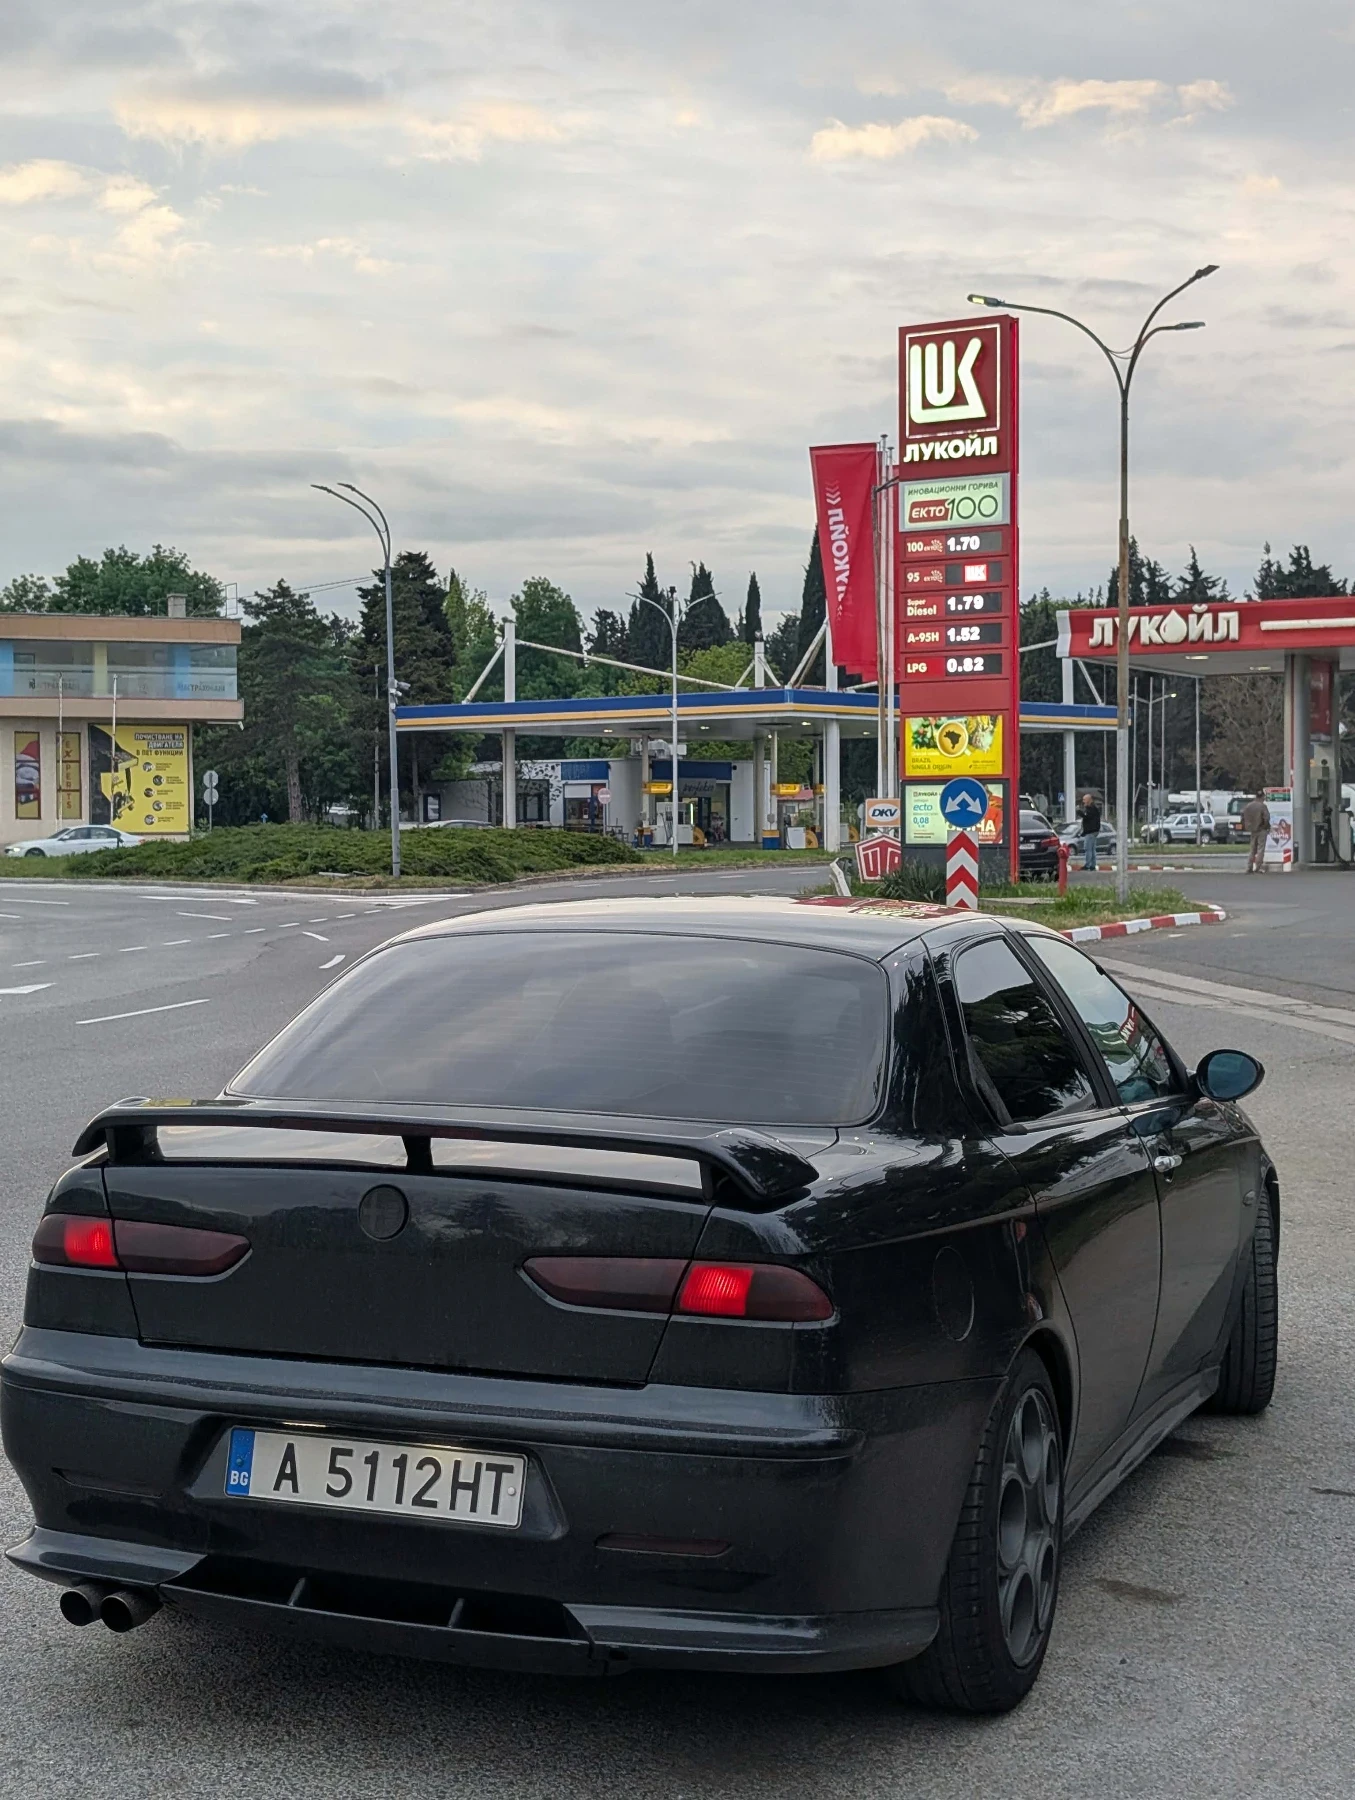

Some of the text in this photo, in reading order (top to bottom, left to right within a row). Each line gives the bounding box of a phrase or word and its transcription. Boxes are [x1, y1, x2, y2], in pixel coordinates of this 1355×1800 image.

[903, 434, 998, 463] ЛУКОЙЛ
[907, 481, 999, 496] ИНОВАЦИОННИ ГОРИВА
[907, 541, 924, 553] 100
[947, 535, 980, 552] 1.70
[907, 572, 920, 583] 95
[907, 598, 926, 606] Super
[907, 595, 984, 617] Diesel 1.79
[947, 626, 981, 642] 1.52
[907, 657, 985, 674] LPG 0.82
[871, 808, 898, 817] DKV
[912, 803, 933, 811] ecto
[912, 816, 930, 825] 0,08
[229, 1442, 515, 1516] BG A 5112HT
